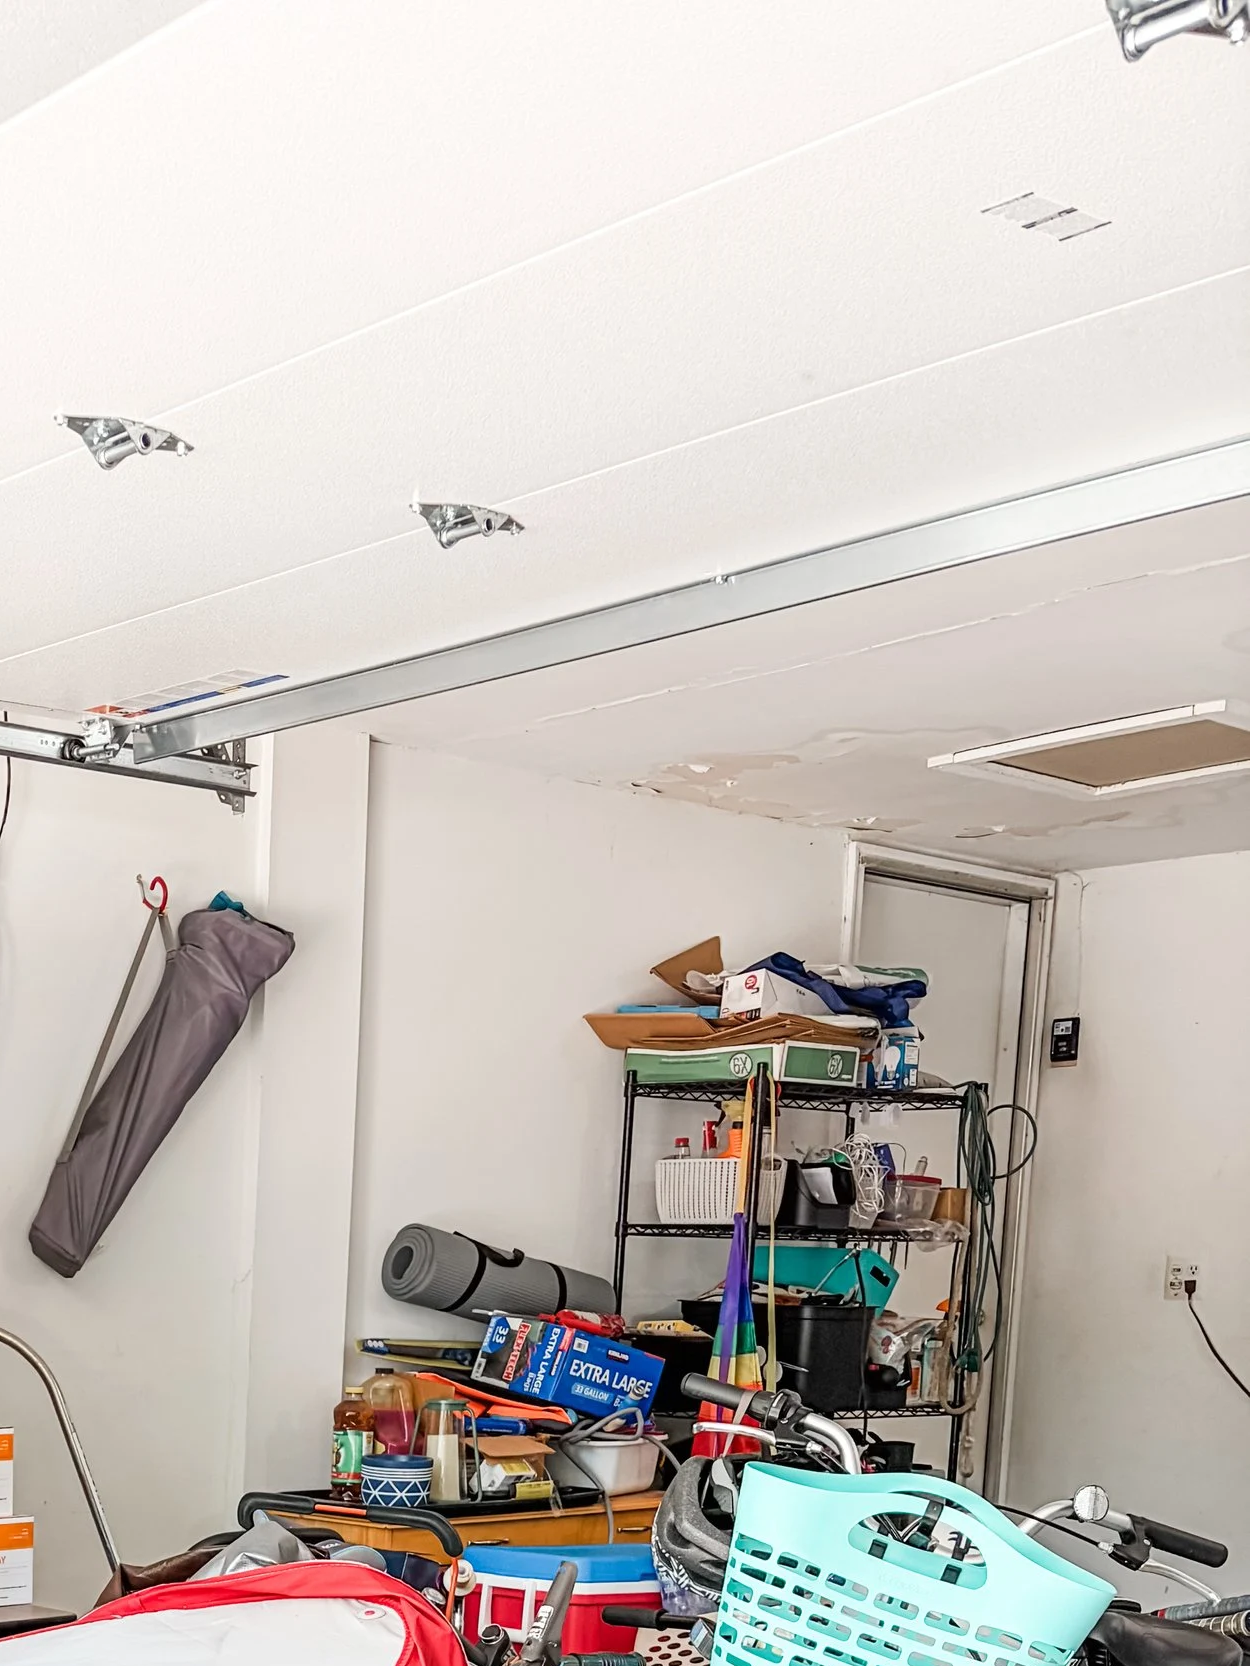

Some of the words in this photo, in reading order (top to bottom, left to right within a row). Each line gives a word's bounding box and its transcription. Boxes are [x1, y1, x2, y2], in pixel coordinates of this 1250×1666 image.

[496, 1326, 509, 1344] 33
[543, 1327, 561, 1359] EXTRA
[532, 1361, 549, 1395] LARGE
[569, 1359, 610, 1386] EXTRA
[574, 1384, 584, 1393] 33
[584, 1387, 610, 1401] GALLON
